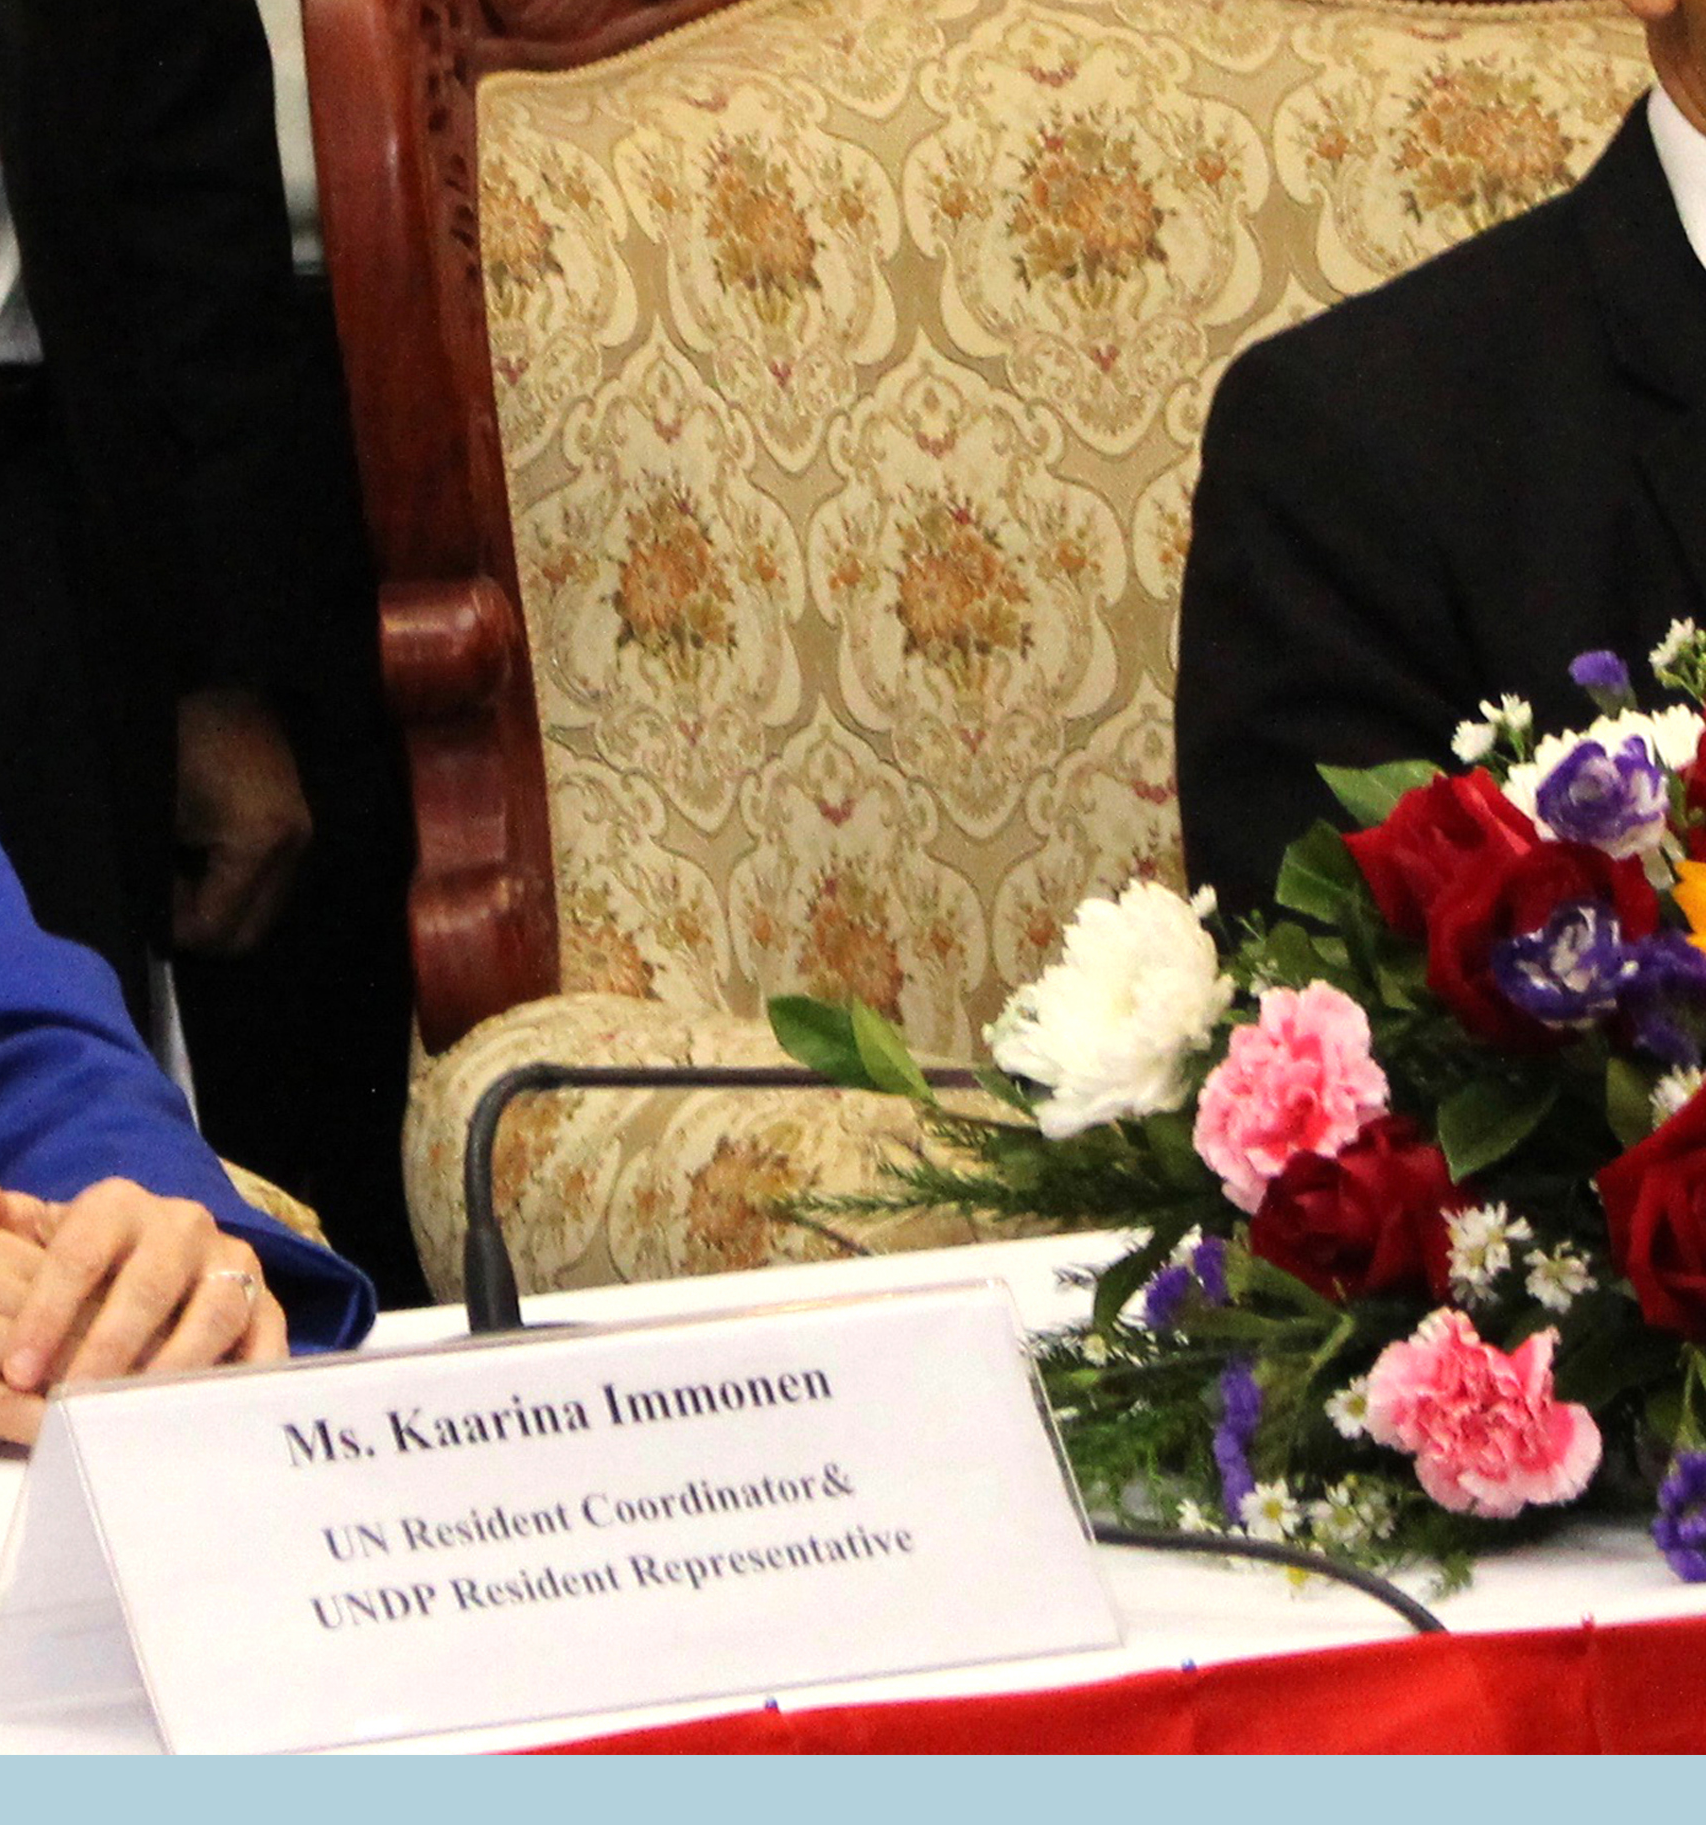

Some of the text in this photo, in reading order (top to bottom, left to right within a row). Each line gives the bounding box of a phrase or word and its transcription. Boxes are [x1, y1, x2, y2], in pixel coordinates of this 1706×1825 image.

[282, 1368, 833, 1467] Ms. Kaarina Immonen
[323, 1462, 855, 1562] UN Resident Coordinator&
[310, 1525, 915, 1630] UNDP Resident Representative
